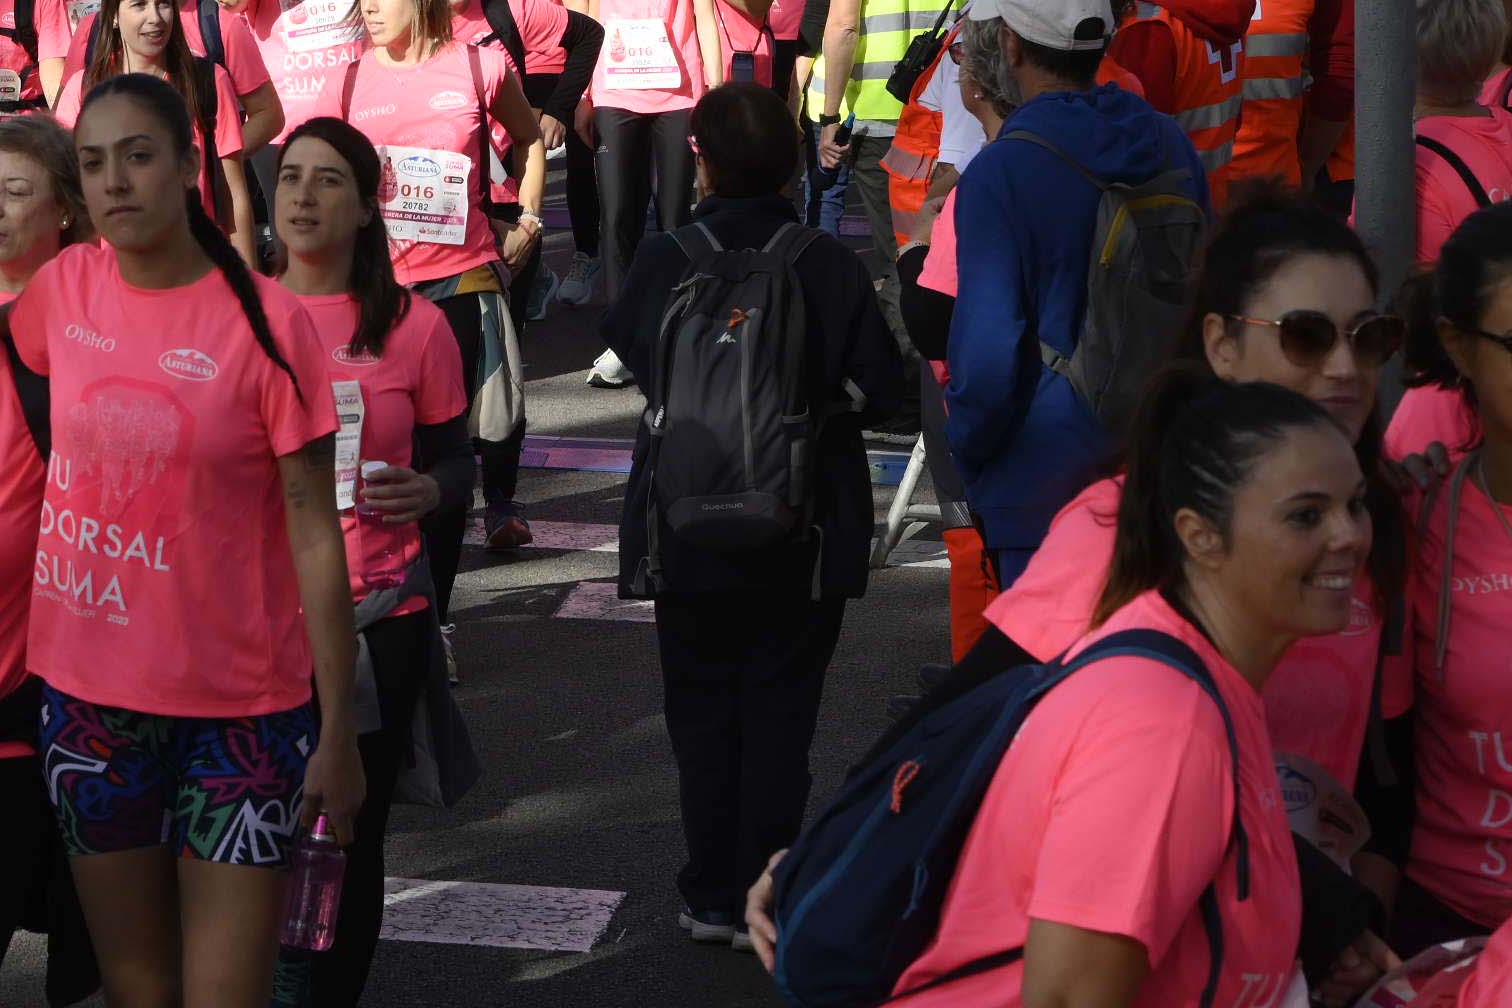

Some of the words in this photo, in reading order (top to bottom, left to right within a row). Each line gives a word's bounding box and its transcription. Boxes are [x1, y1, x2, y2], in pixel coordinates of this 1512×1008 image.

[400, 184, 435, 200] 016
[402, 201, 430, 212] 20782
[65, 323, 116, 353] OYSHO
[162, 355, 216, 378] ASTURIANA
[701, 501, 744, 512] Quechua
[38, 499, 172, 572] DORSAL
[34, 550, 128, 612] SUMA
